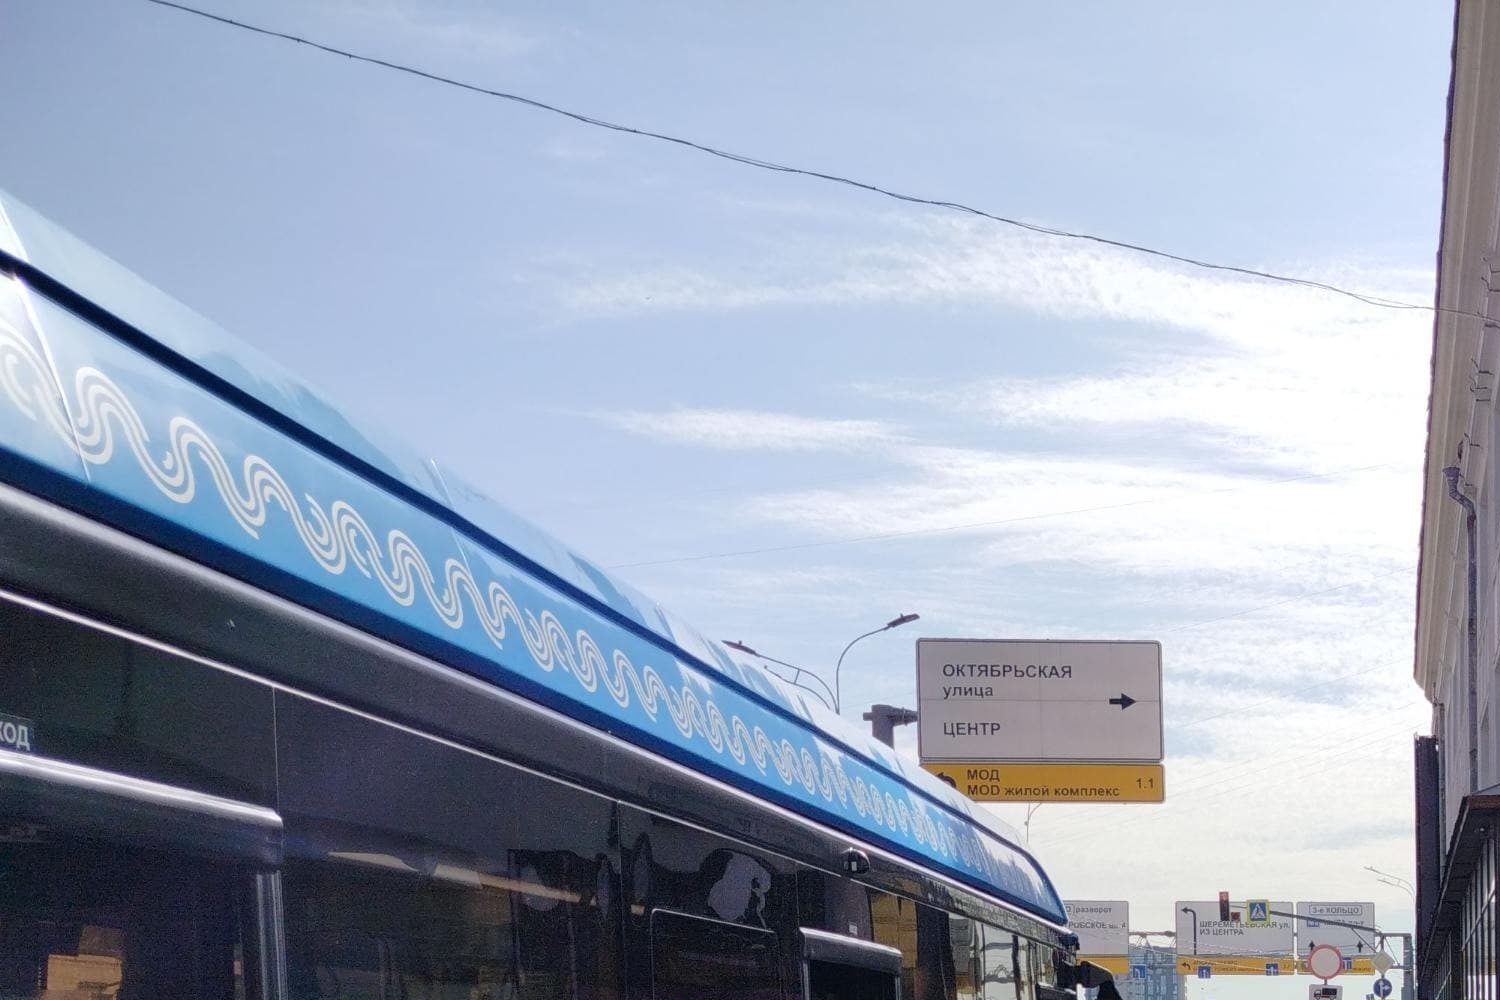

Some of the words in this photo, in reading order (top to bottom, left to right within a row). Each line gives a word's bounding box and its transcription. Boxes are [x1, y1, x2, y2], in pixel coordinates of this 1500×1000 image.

[942, 664, 1072, 679] ОКТЯБРЬСКАЯ
[942, 685, 994, 700] улица
[943, 722, 1001, 737] ЦЕНТР
[967, 769, 1000, 782] МОД
[1136, 778, 1155, 789] 1.1
[1004, 784, 1049, 796] жилой
[1054, 785, 1120, 797] комплекс
[1213, 929, 1244, 937] ЦЕНТРА
